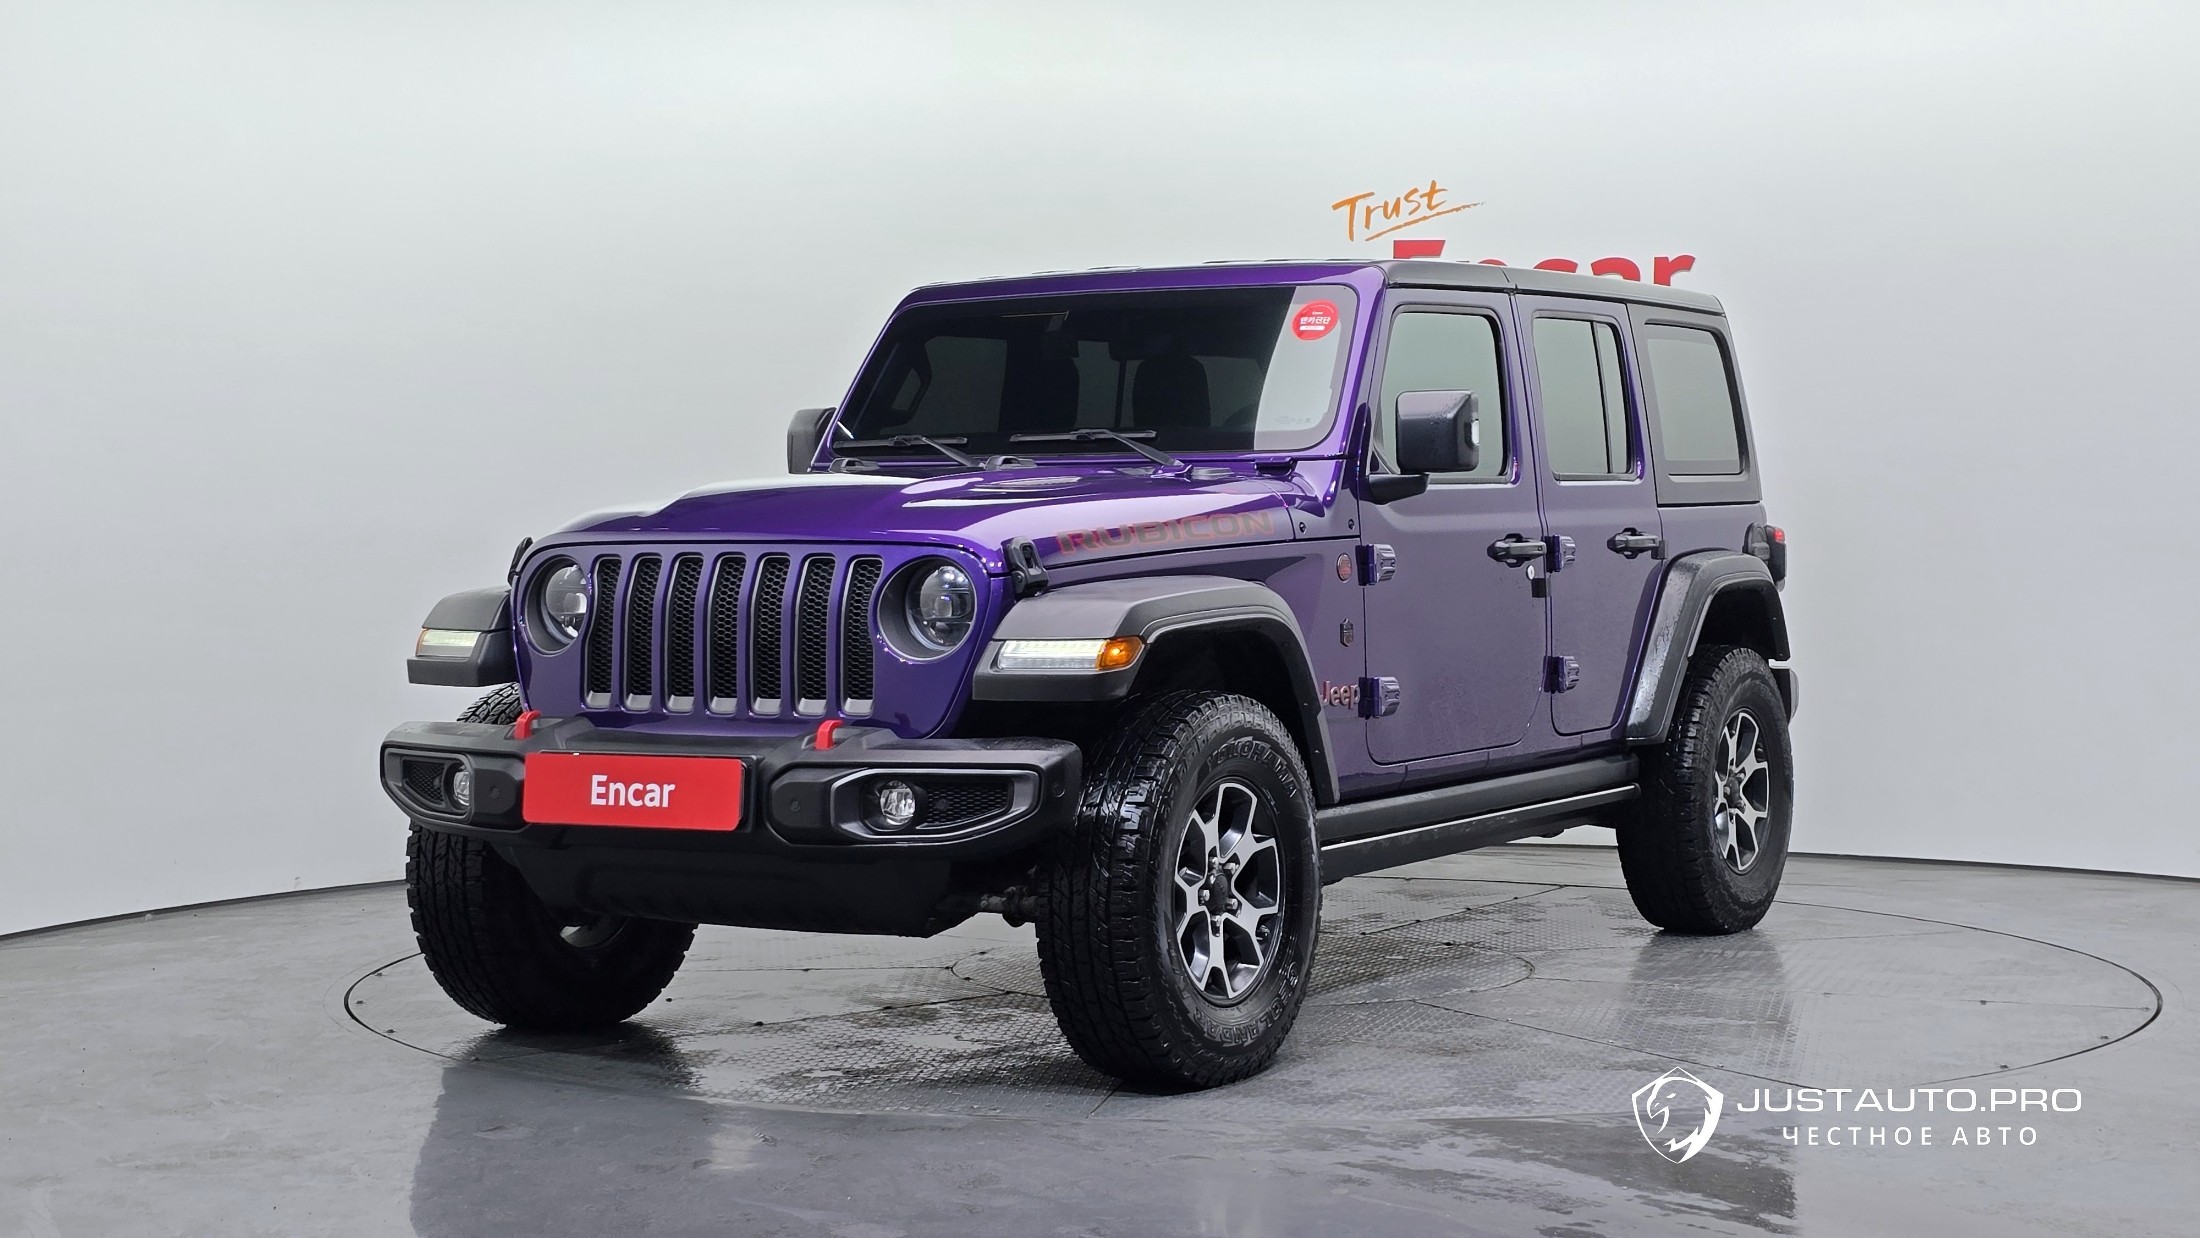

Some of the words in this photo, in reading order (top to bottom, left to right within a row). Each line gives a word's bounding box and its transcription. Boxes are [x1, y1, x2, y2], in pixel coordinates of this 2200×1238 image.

[1331, 179, 1448, 242] Trust
[1056, 510, 1275, 555] RUBICON
[1321, 680, 1360, 710] Jeep
[1205, 736, 1300, 799] YOKOHAMA
[590, 774, 676, 808] Encar
